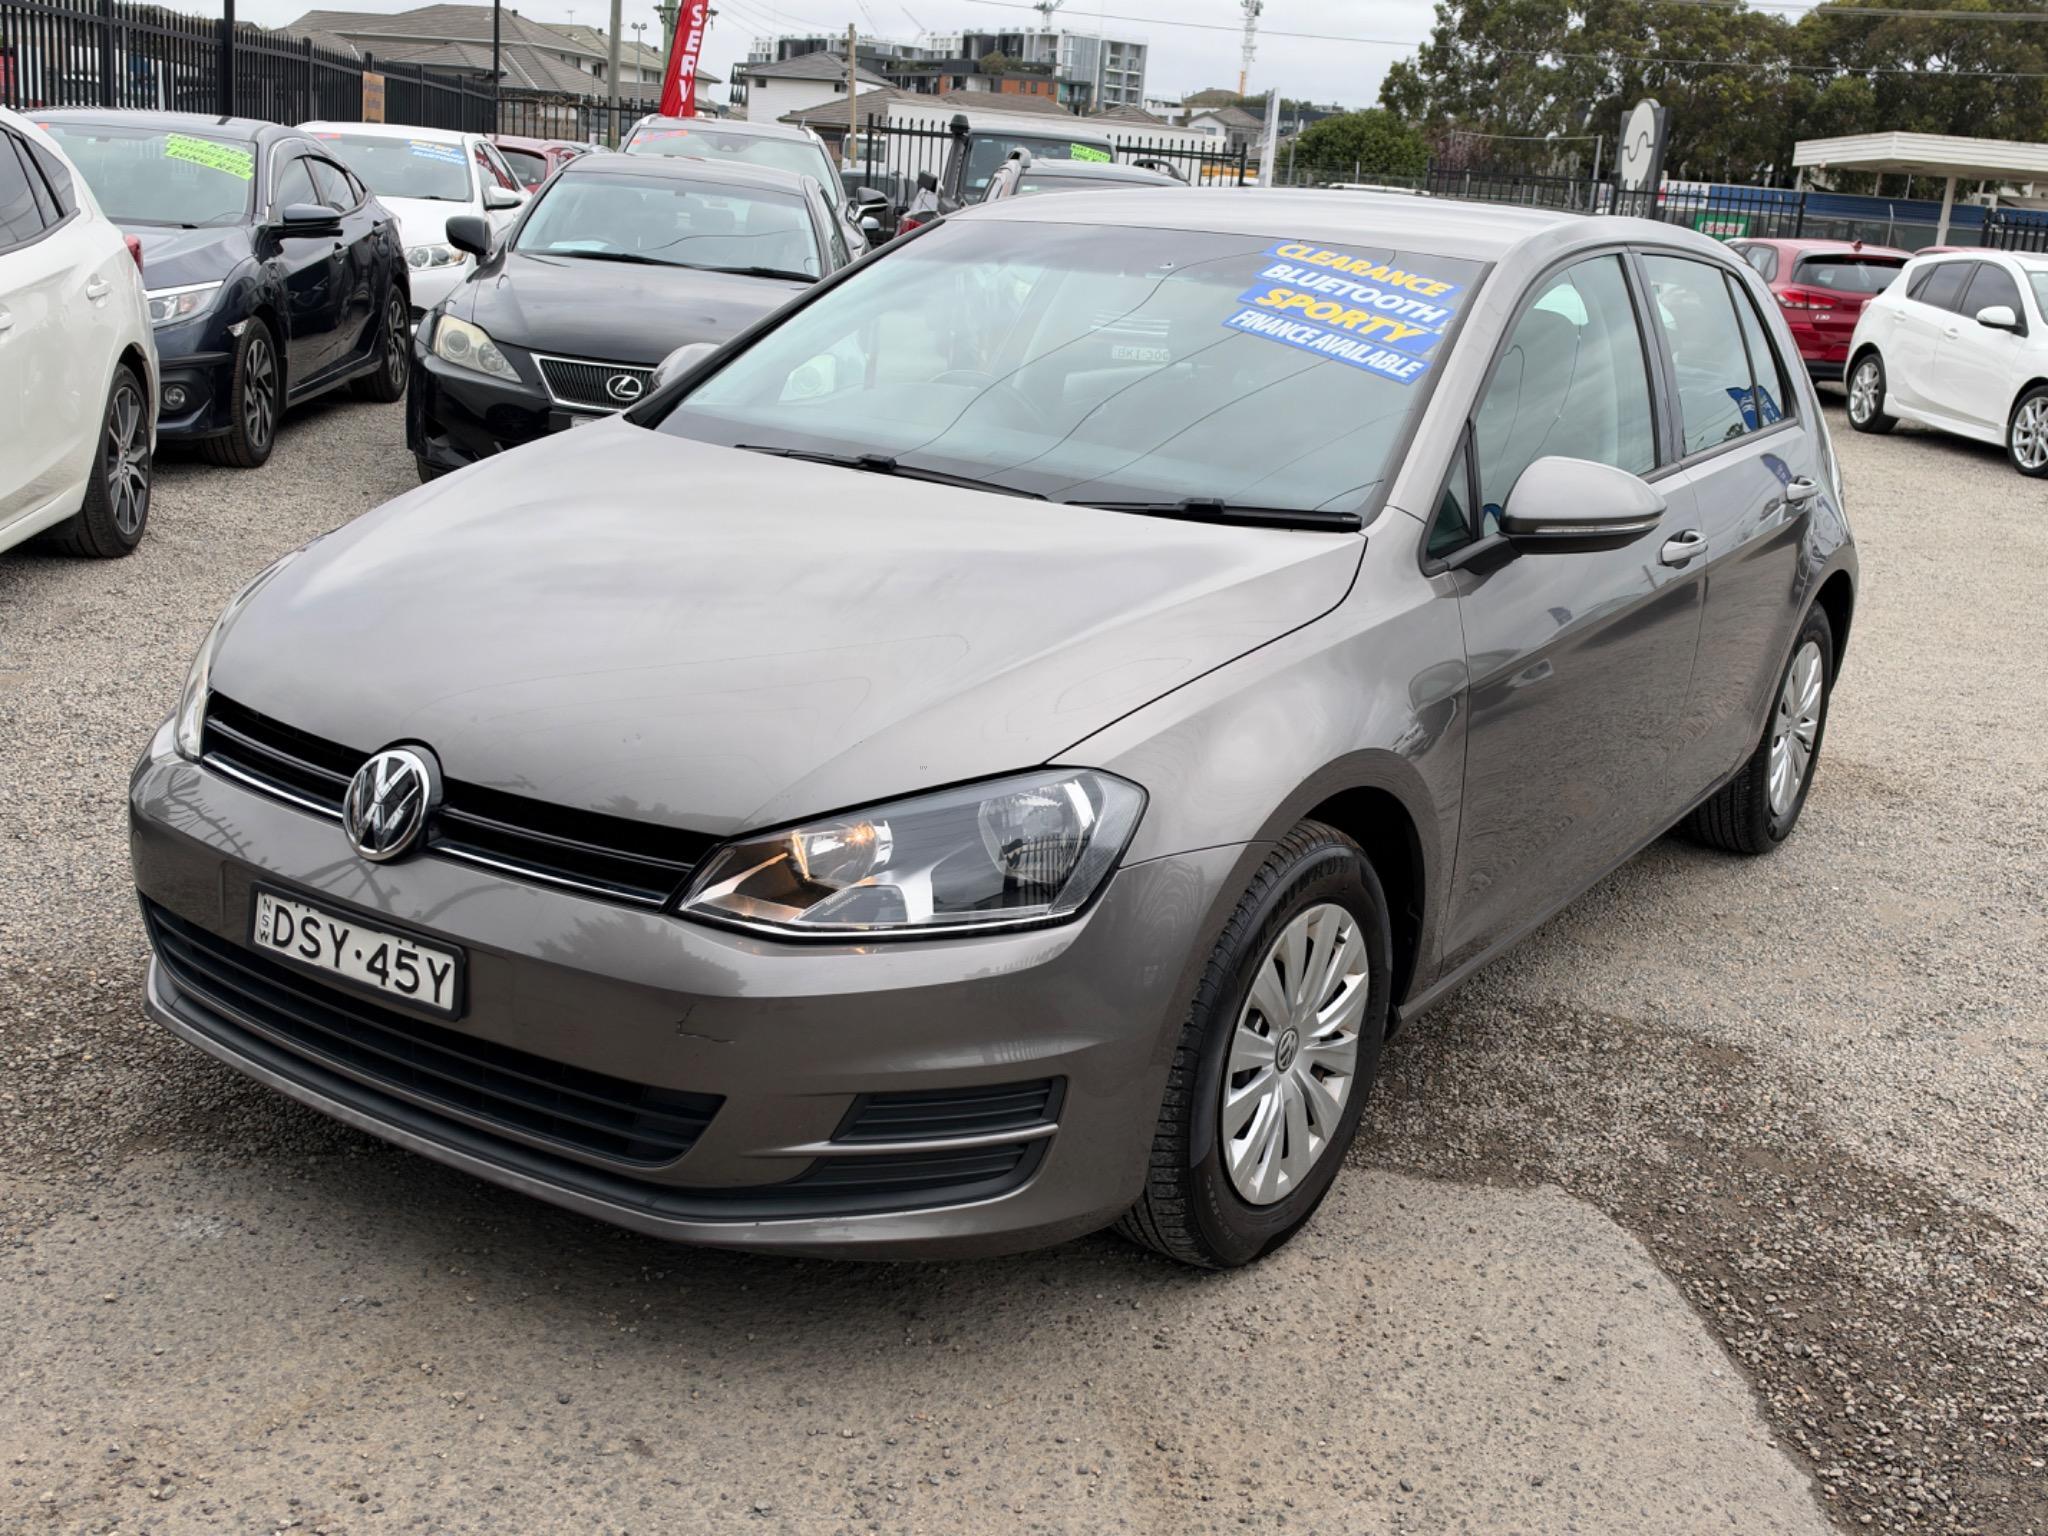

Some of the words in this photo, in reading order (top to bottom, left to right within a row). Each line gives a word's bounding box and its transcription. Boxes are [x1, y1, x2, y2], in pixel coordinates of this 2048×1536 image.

[1262, 264, 1448, 322] BLUETOOTH
[1277, 244, 1453, 297] CLEARANCE
[1256, 288, 1423, 342] SPORTY
[1232, 310, 1321, 344] FINANCE
[1314, 334, 1423, 378] AVAILABLE
